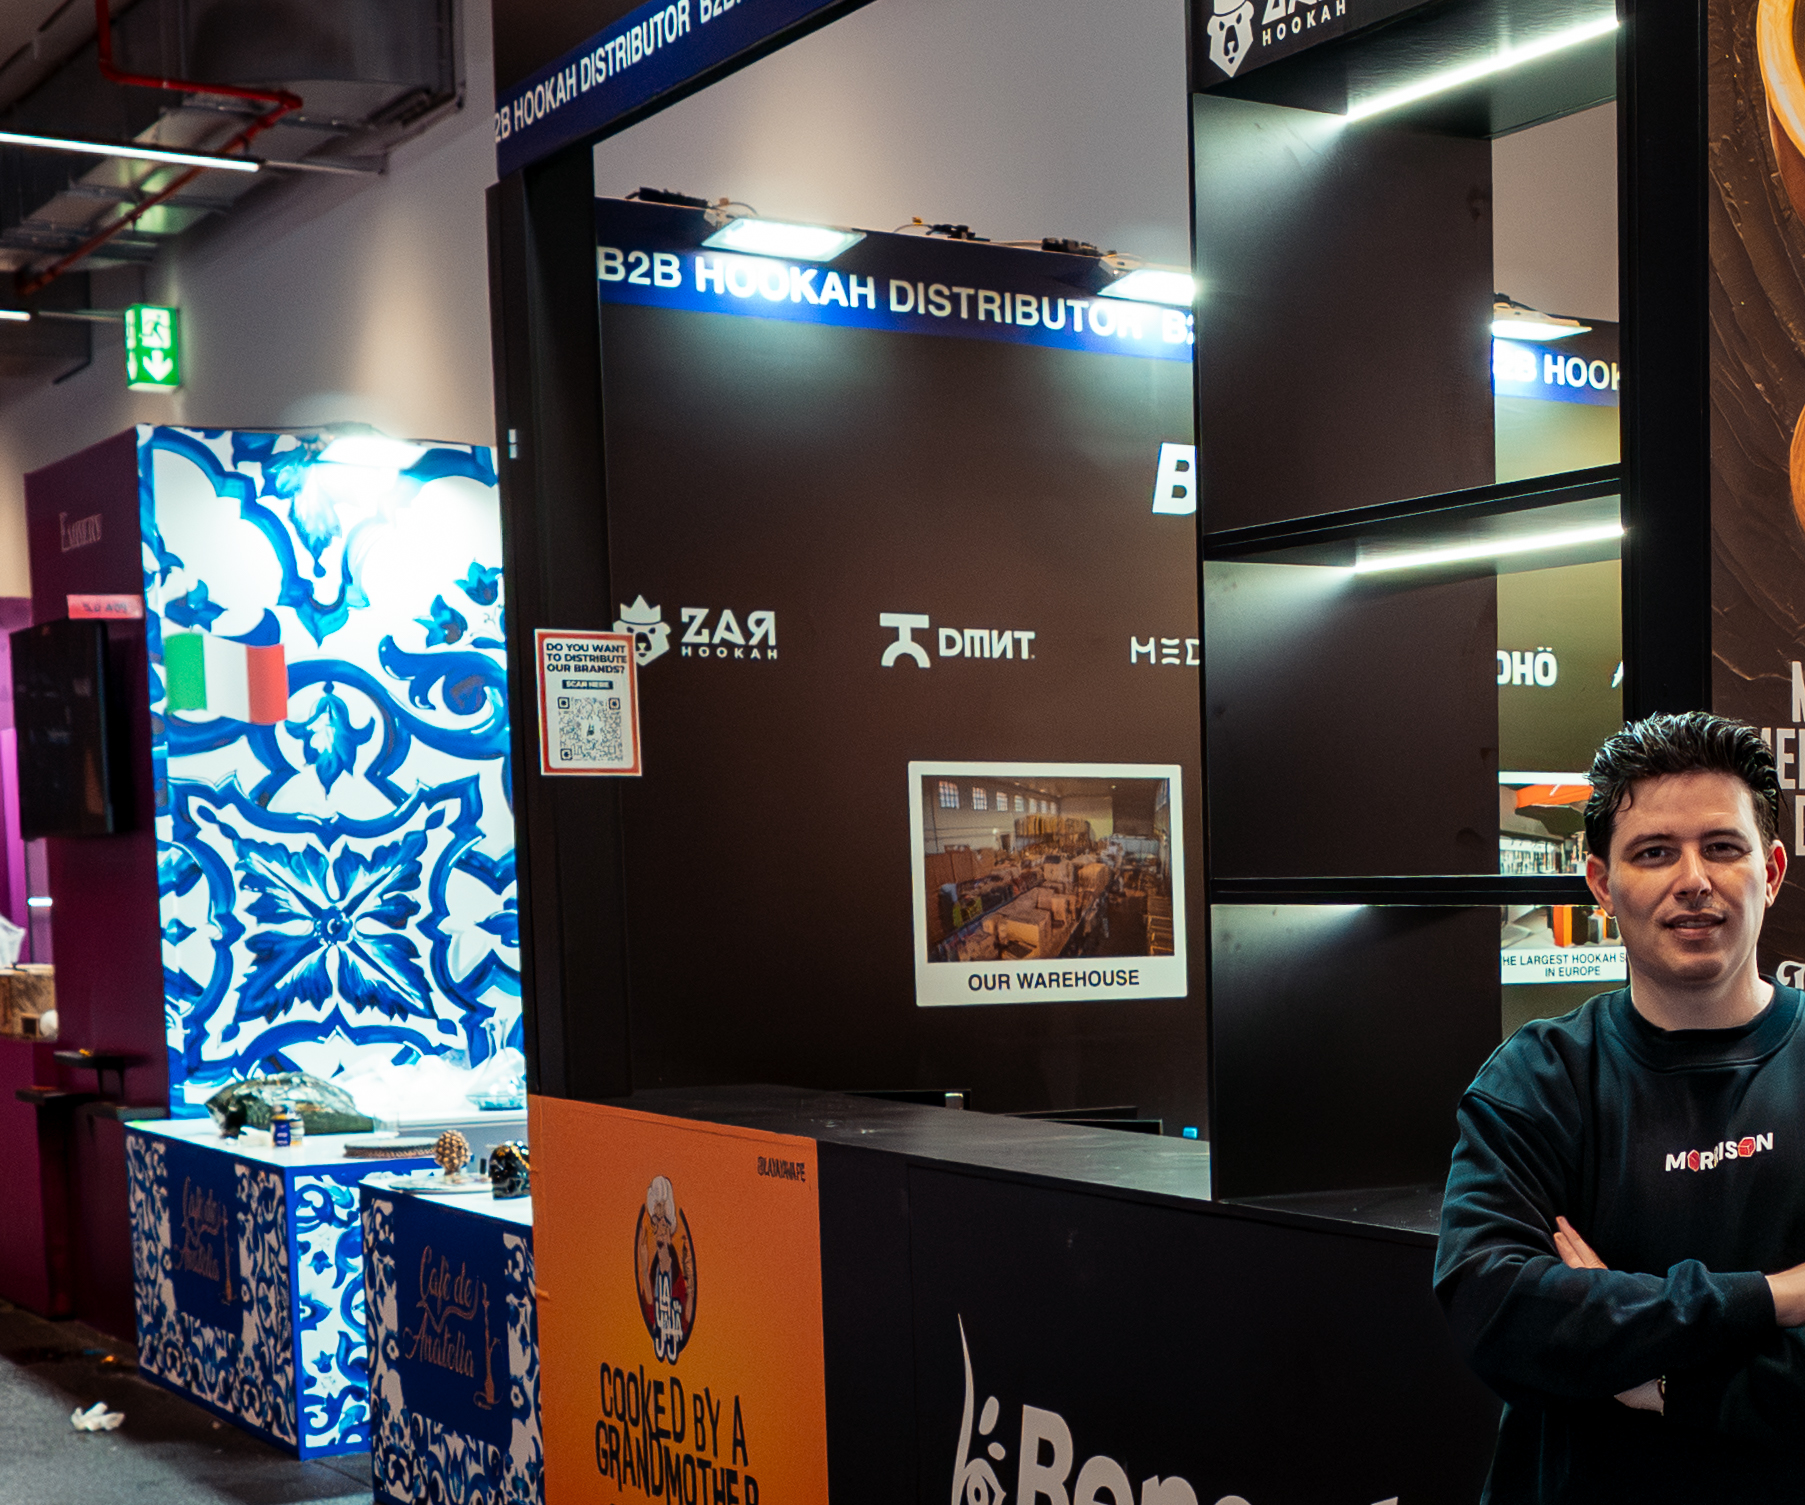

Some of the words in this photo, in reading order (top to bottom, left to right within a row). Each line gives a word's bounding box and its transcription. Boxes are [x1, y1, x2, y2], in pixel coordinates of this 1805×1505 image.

[514, 62, 578, 133] HOOKAH
[597, 246, 682, 289] B2B
[694, 255, 876, 309] HOOKAH
[888, 279, 1143, 340] DISTRIBUTOR
[546, 643, 563, 652] DO
[566, 643, 589, 652] YOU
[592, 644, 626, 653] WANT
[681, 646, 778, 660] HOOKAH
[546, 653, 561, 662] TO
[565, 654, 627, 664] DISTRIBUTE
[547, 663, 571, 673] OUR
[574, 664, 625, 674] BRANDS?
[1520, 954, 1568, 966] LARGEST
[1572, 953, 1617, 964] HOOKAH
[1544, 967, 1555, 977] IN
[1558, 965, 1601, 977] EUROPE
[968, 973, 1011, 991] OUR
[1016, 969, 1140, 990] WAREHOUSE
[600, 1362, 686, 1444] COOKED
[693, 1386, 720, 1460] BY
[732, 1395, 749, 1468] A
